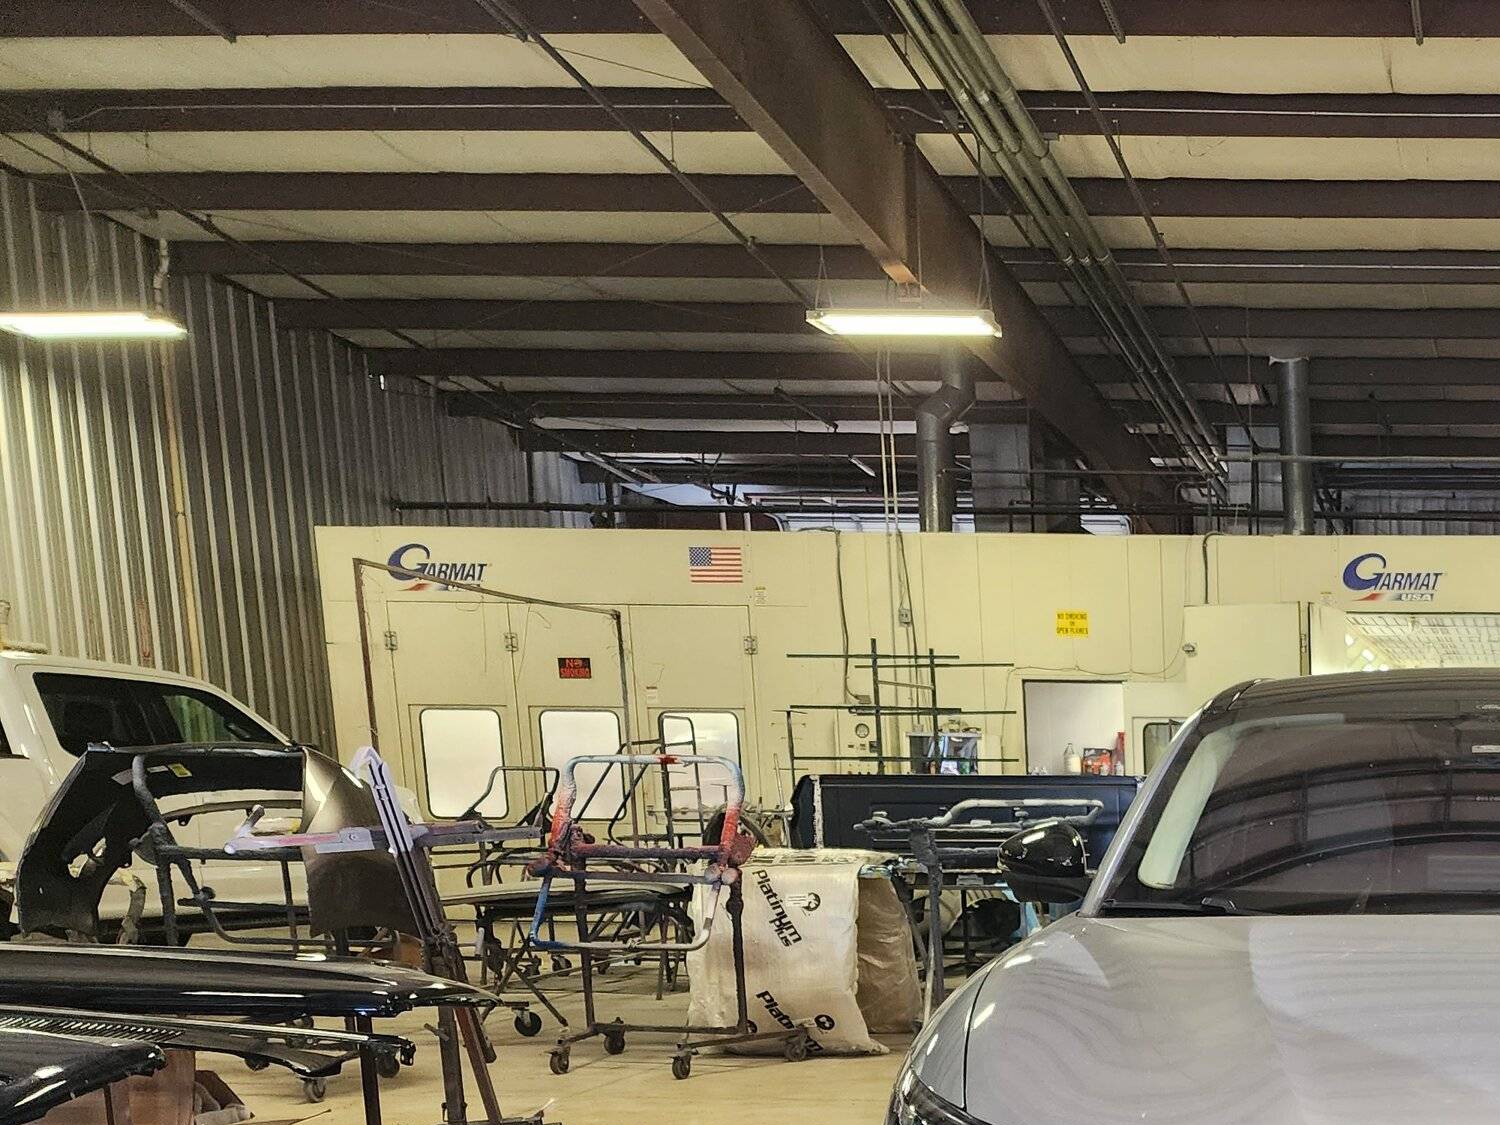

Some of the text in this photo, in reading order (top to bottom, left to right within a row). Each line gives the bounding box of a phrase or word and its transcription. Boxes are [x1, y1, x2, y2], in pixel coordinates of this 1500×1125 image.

[387, 543, 487, 580] GARMAT
[1343, 553, 1443, 591] GARMAT
[1400, 593, 1434, 601] USA
[565, 659, 582, 668] NO
[752, 869, 802, 944] Platinum
[769, 916, 793, 948] Plus
